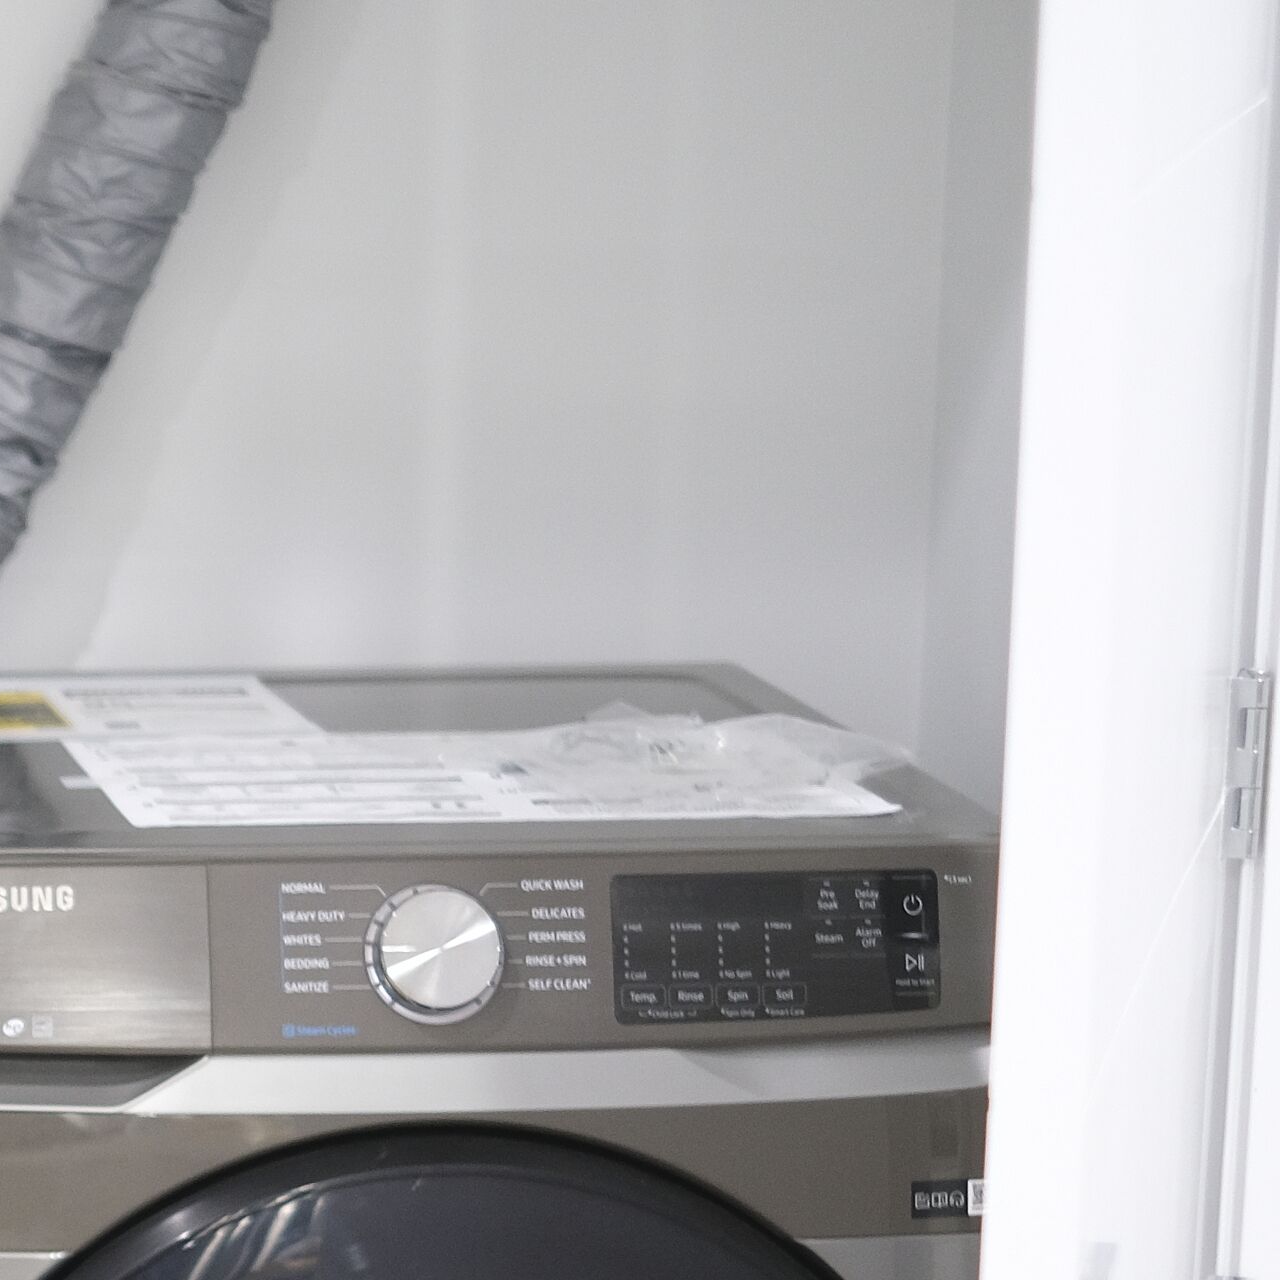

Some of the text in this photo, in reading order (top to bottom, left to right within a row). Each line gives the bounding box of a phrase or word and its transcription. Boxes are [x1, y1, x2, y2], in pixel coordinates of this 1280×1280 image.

[281, 882, 326, 894] NORMAL
[520, 879, 584, 892] QUICK WASH
[820, 889, 835, 899] Pre
[854, 888, 880, 899] Delay
[858, 899, 876, 910] End
[282, 910, 345, 923] HEAVY DUTY
[531, 907, 585, 919] DELICATES
[528, 931, 586, 943] PERM PRESS
[815, 932, 844, 944] Steam
[855, 927, 882, 938] Alarm
[283, 933, 322, 946] WHITES
[862, 938, 876, 949] Off
[284, 957, 330, 970] BEDDING
[525, 954, 555, 967] RINSE
[562, 954, 587, 967] SPIN
[284, 981, 329, 993] SANITIZE
[528, 978, 553, 991] SELF
[678, 990, 704, 1002] Rinse
[727, 989, 749, 1002] Spin
[775, 988, 794, 1001] Soil
